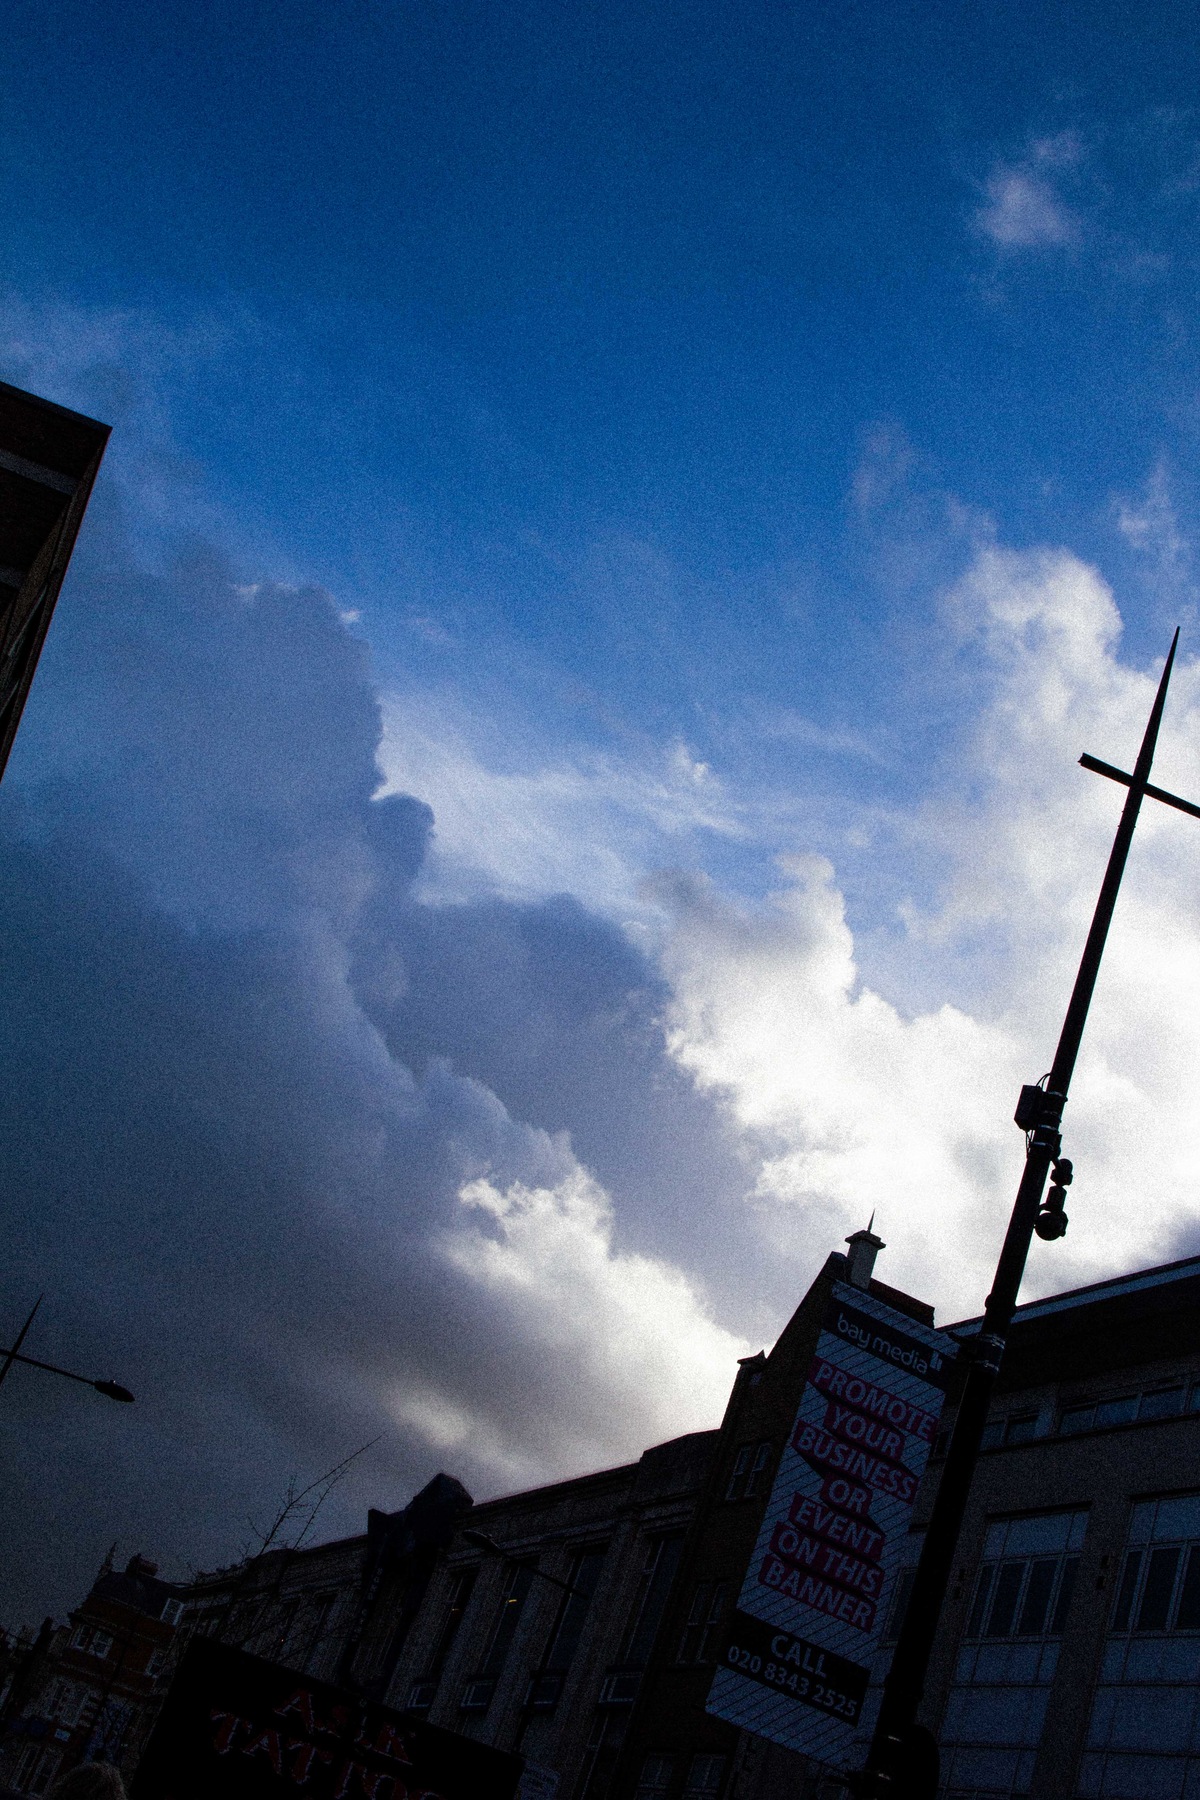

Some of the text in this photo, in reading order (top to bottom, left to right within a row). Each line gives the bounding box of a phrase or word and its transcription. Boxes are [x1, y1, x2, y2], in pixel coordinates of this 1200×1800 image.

[836, 1312, 929, 1375] bay media
[813, 1362, 936, 1440] PROMOTE
[831, 1401, 901, 1460] YOUR
[797, 1427, 915, 1500] BUSINESS
[828, 1478, 868, 1514] OR
[794, 1499, 883, 1555] EVENT
[777, 1529, 880, 1594] ON THIS
[764, 1560, 873, 1629] BANNER
[726, 1644, 859, 1718] 020 8343 2525
[769, 1633, 827, 1679] CALL
[208, 1706, 446, 1800] TATTO
